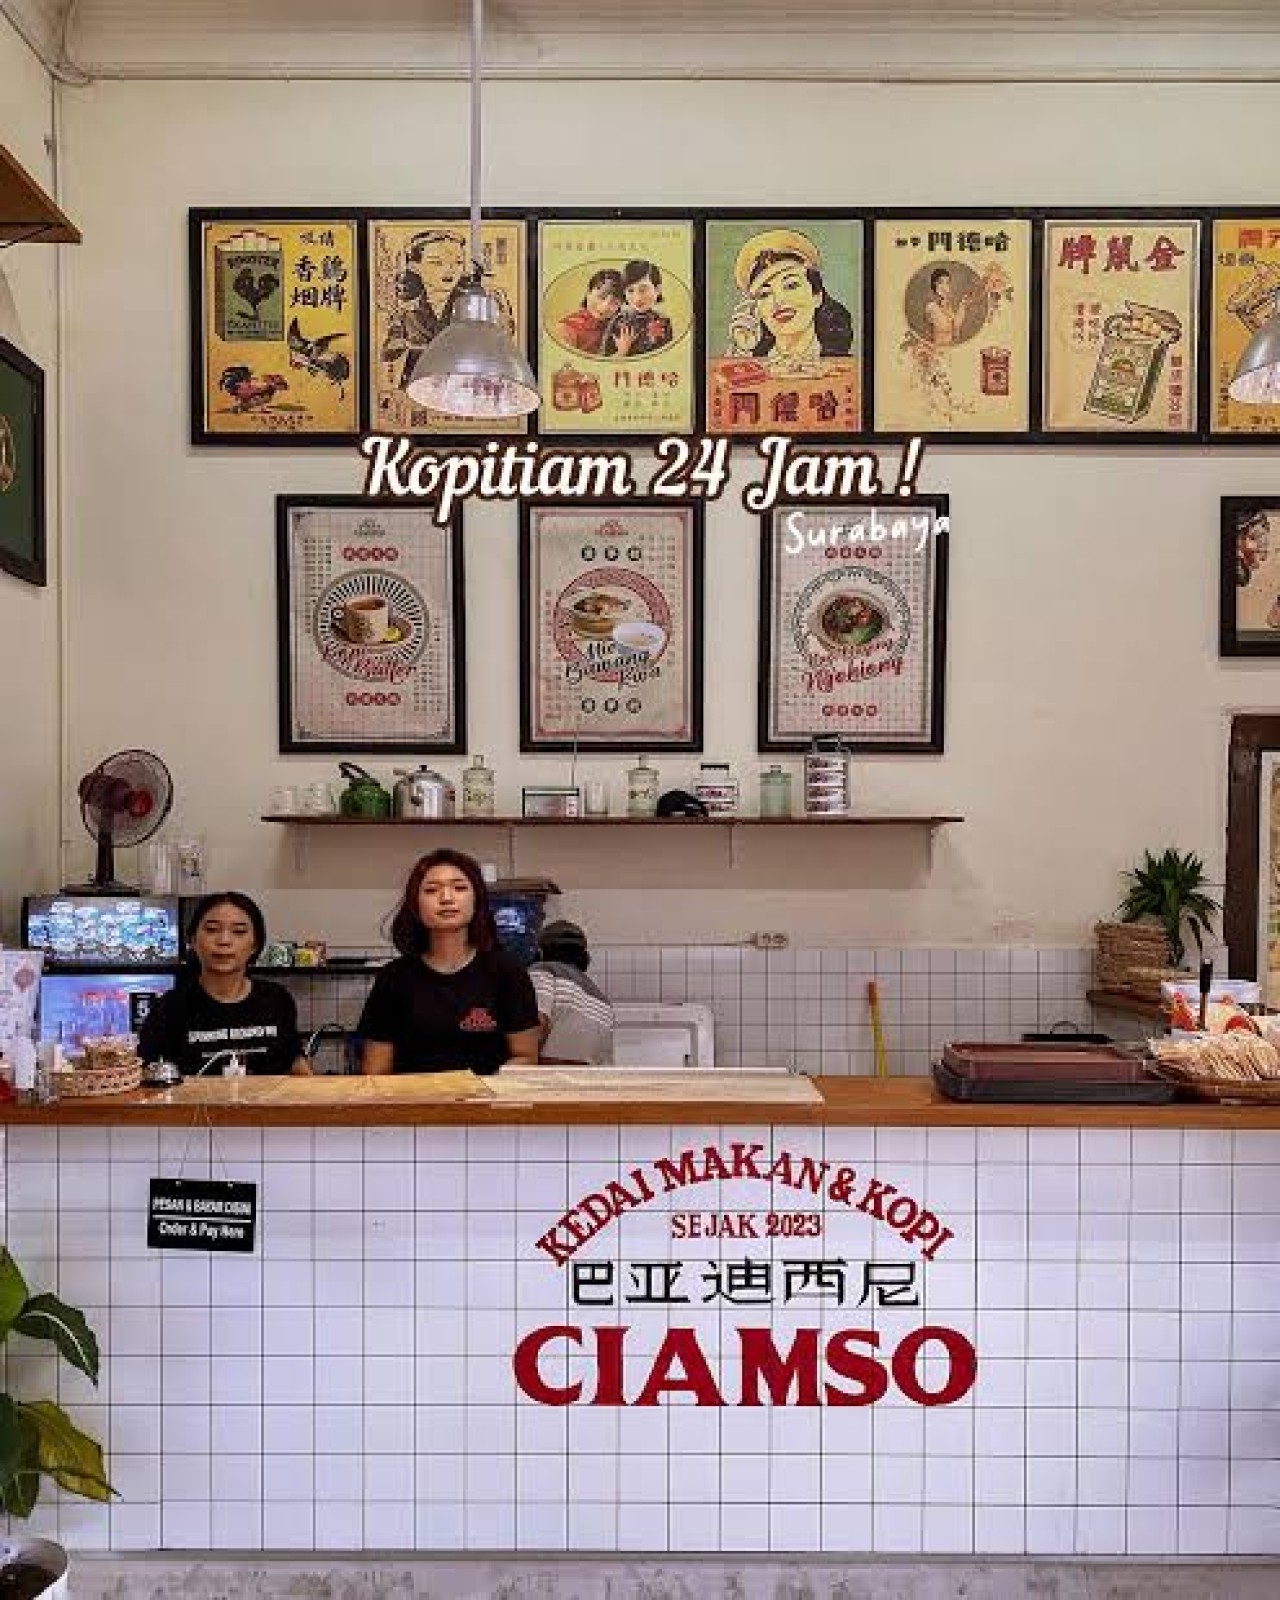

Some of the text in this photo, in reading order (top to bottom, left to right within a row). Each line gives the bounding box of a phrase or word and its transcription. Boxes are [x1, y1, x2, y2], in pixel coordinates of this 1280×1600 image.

[535, 1144, 955, 1267] KEDAI MAKAN & KOPI
[671, 1213, 823, 1239] SEJAK 2023
[572, 1256, 920, 1308] 巴亚迪西尼
[513, 1325, 978, 1407] CIAMSO
